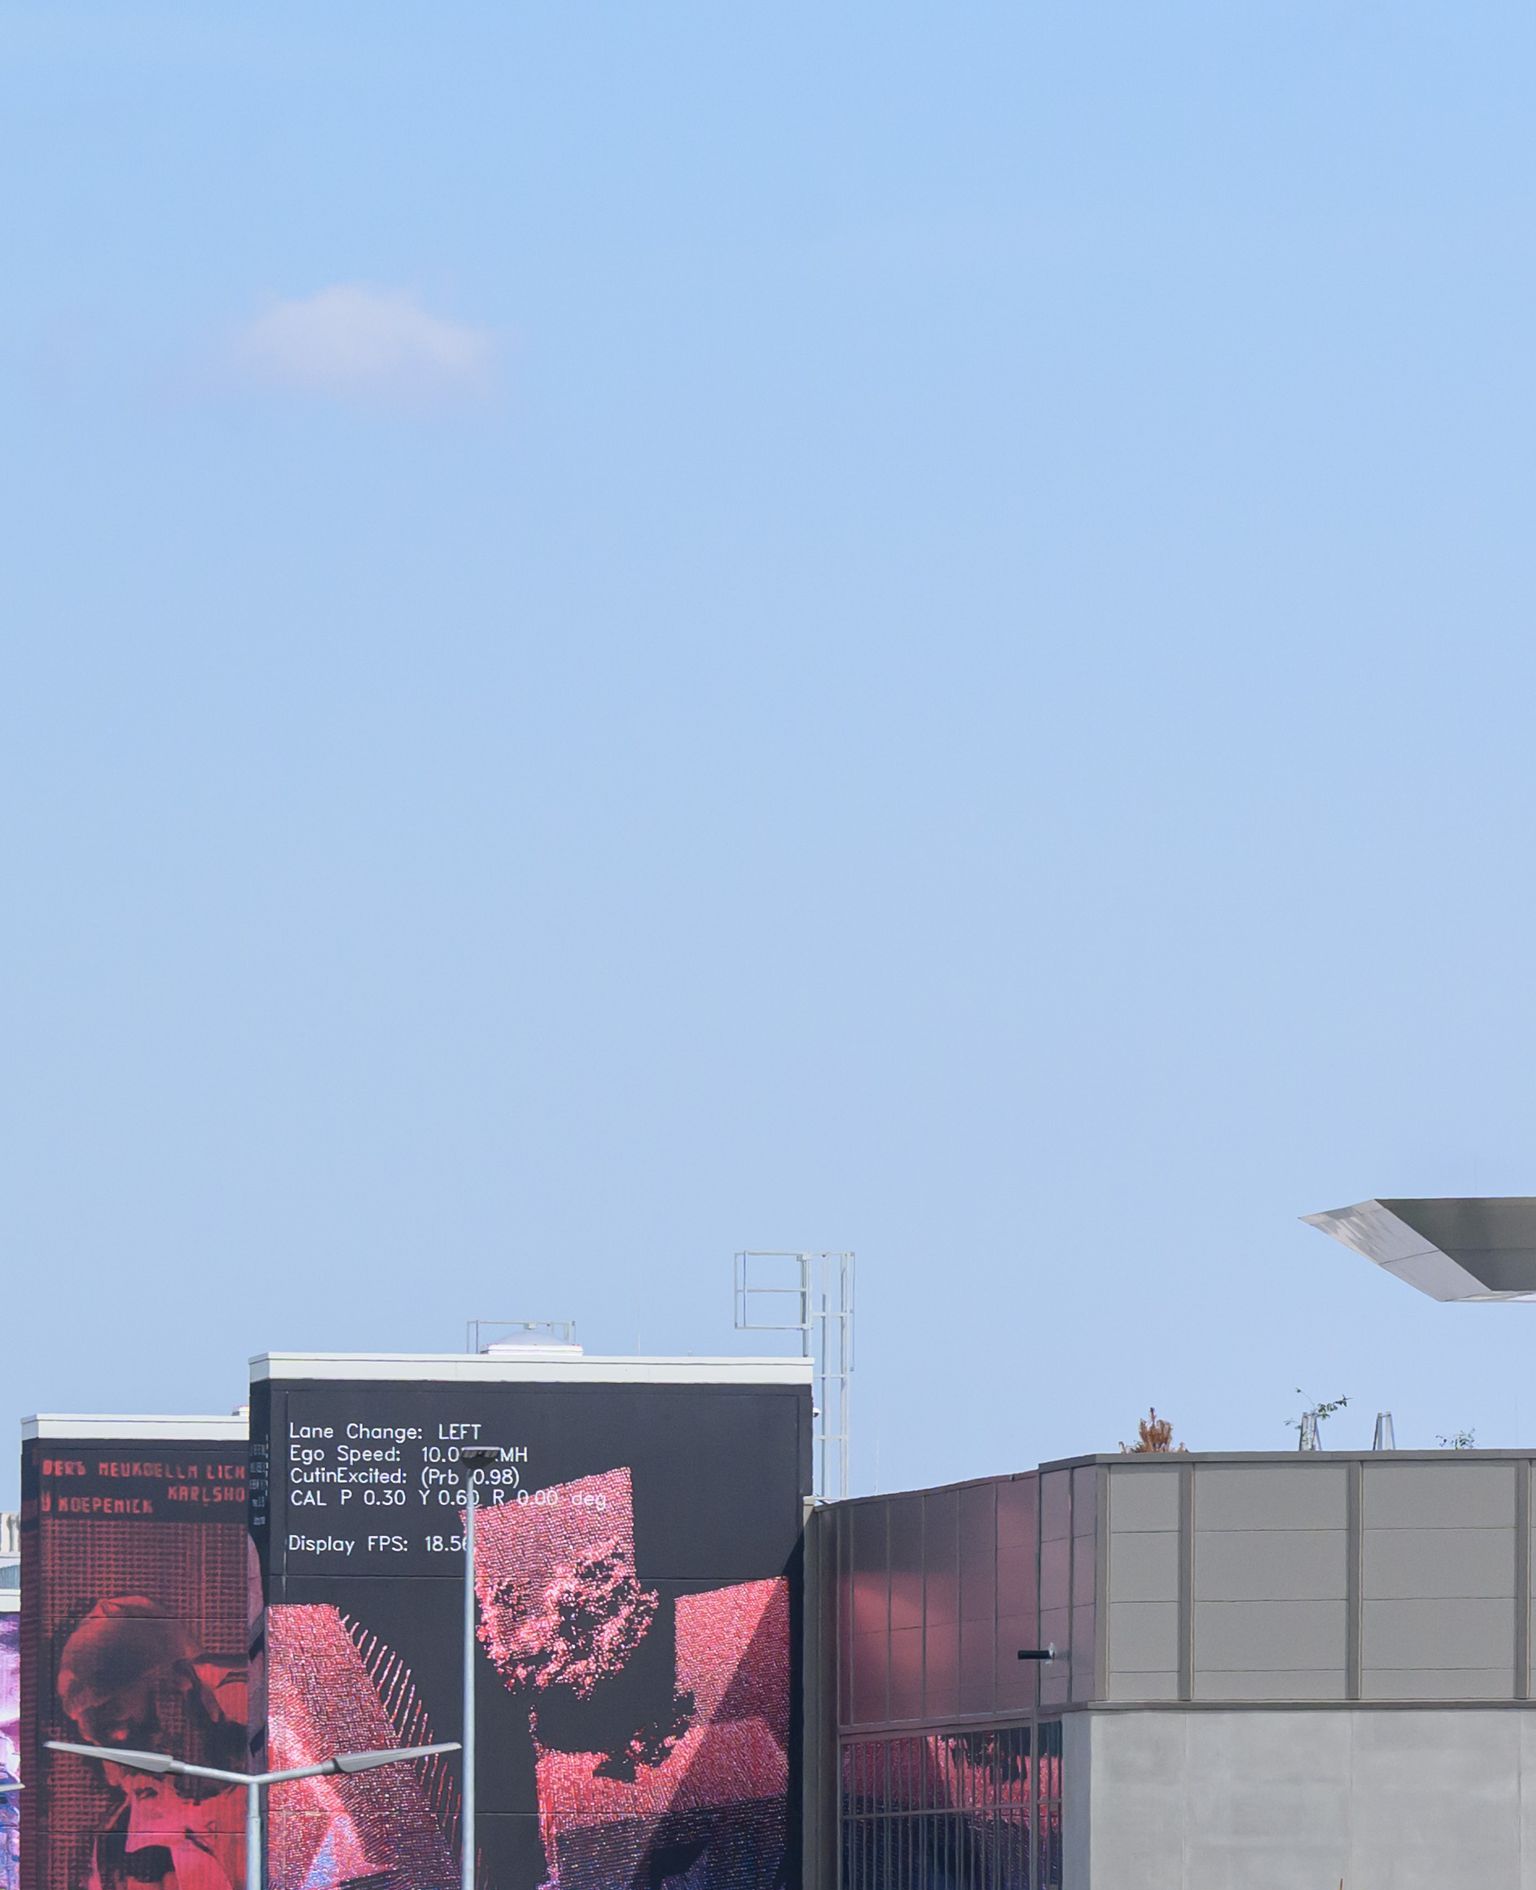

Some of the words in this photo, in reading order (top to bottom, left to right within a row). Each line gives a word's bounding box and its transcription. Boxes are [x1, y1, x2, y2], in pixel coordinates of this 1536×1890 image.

[289, 1423, 334, 1439] Lane
[346, 1423, 423, 1443] Change:
[438, 1424, 481, 1440] LEFT
[290, 1447, 325, 1464] Ego
[337, 1446, 401, 1464] Speed:
[422, 1446, 463, 1462] 10.0
[494, 1446, 528, 1462] MH
[290, 1467, 407, 1484] CutinExcited:
[421, 1466, 459, 1488] (Prb
[473, 1466, 519, 1488] 0.98)
[291, 1489, 327, 1506] CAL
[341, 1489, 352, 1505] P
[363, 1489, 406, 1506] 0.30
[418, 1489, 430, 1505] Y
[493, 1489, 504, 1505] R
[517, 1489, 558, 1506] 0.00
[289, 1535, 355, 1555] Display
[368, 1536, 408, 1551] FPS:
